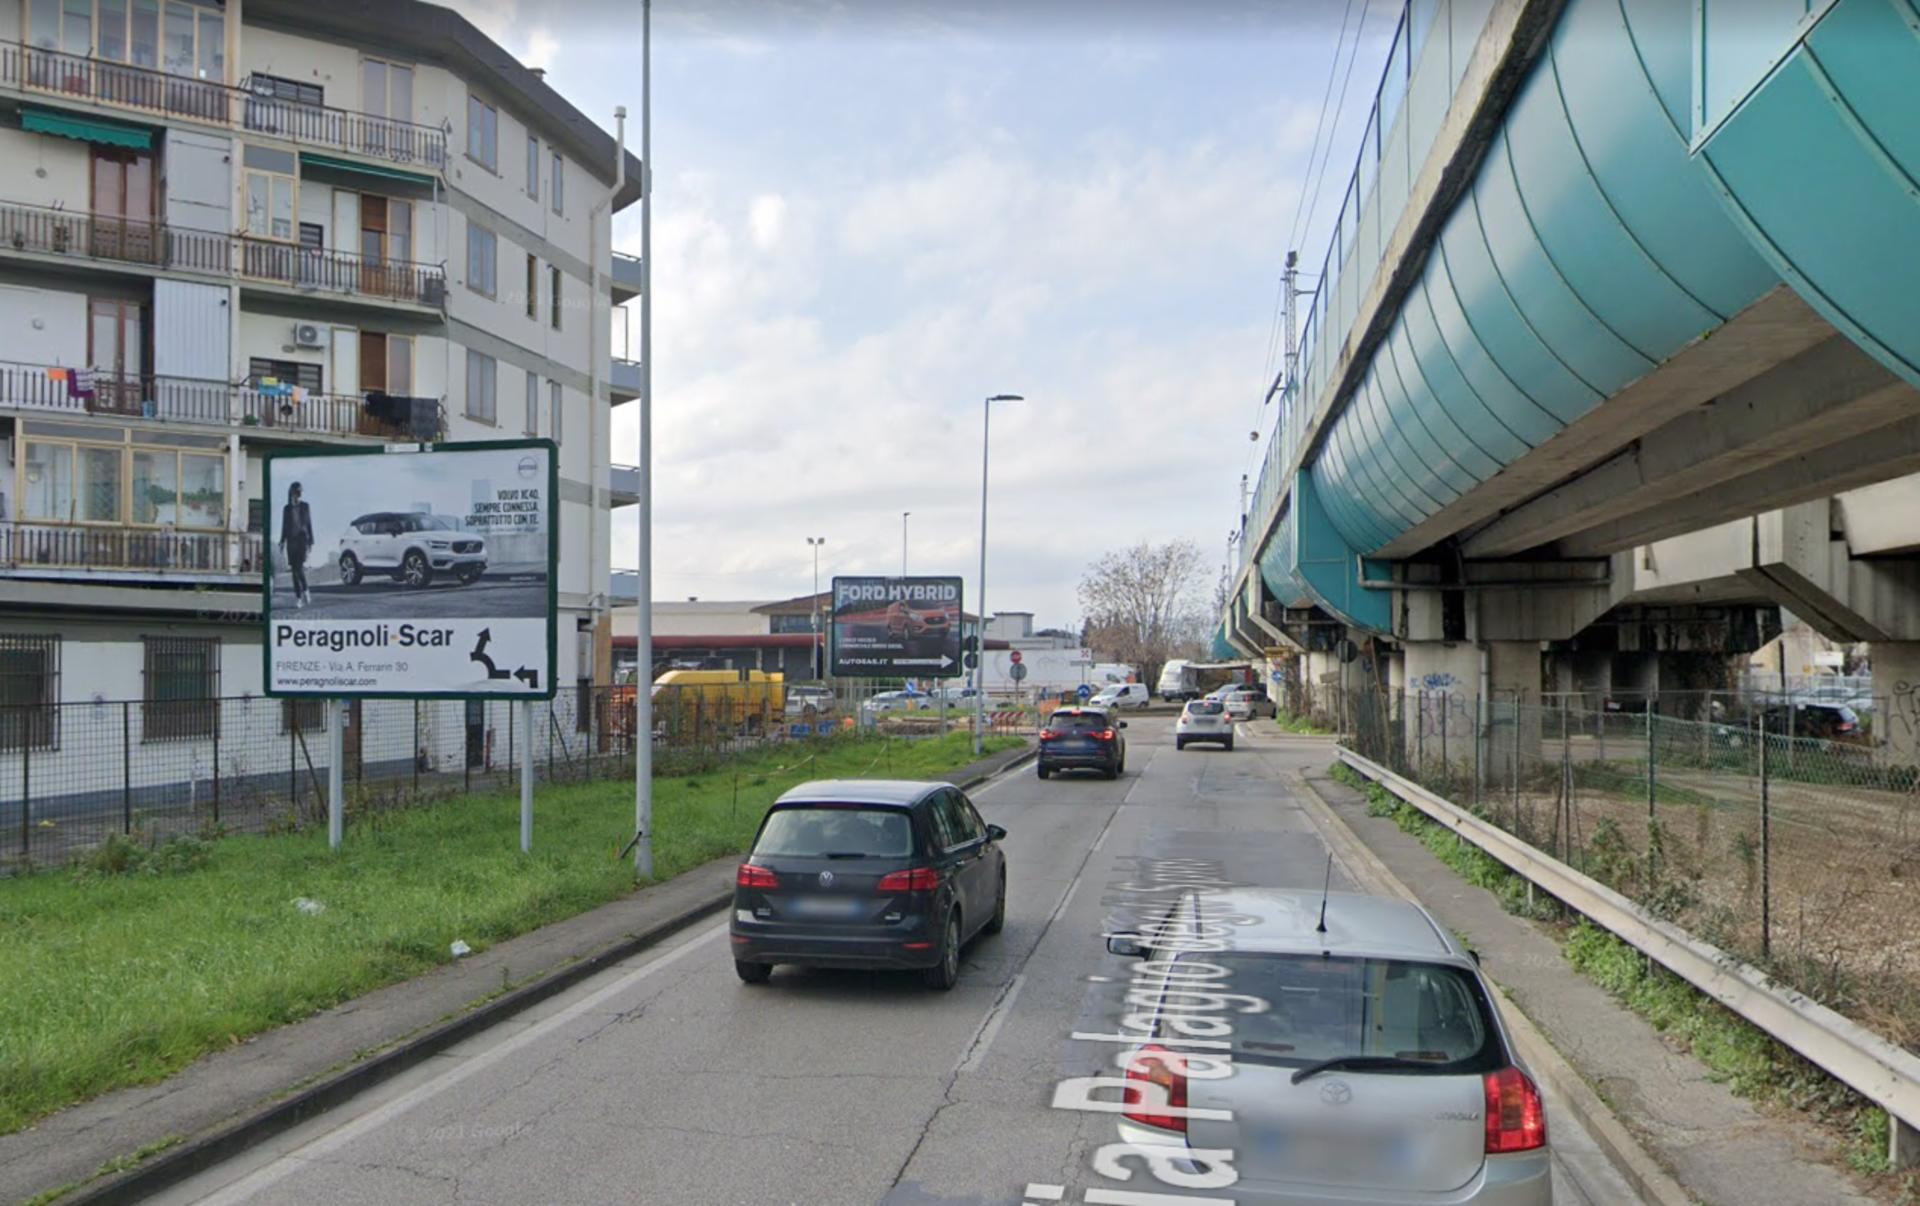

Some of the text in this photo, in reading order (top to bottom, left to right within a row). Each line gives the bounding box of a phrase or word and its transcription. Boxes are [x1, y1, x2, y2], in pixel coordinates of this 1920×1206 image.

[474, 502, 501, 513] SEMPRE
[465, 515, 512, 526] SOPRATTUTTO
[513, 514, 528, 525] CON
[839, 585, 957, 600] FORD HYBRID
[276, 662, 321, 672] FIRENZE
[329, 662, 343, 672] Via
[395, 661, 409, 672] 30
[277, 676, 377, 688] www.peragnoliscar.com
